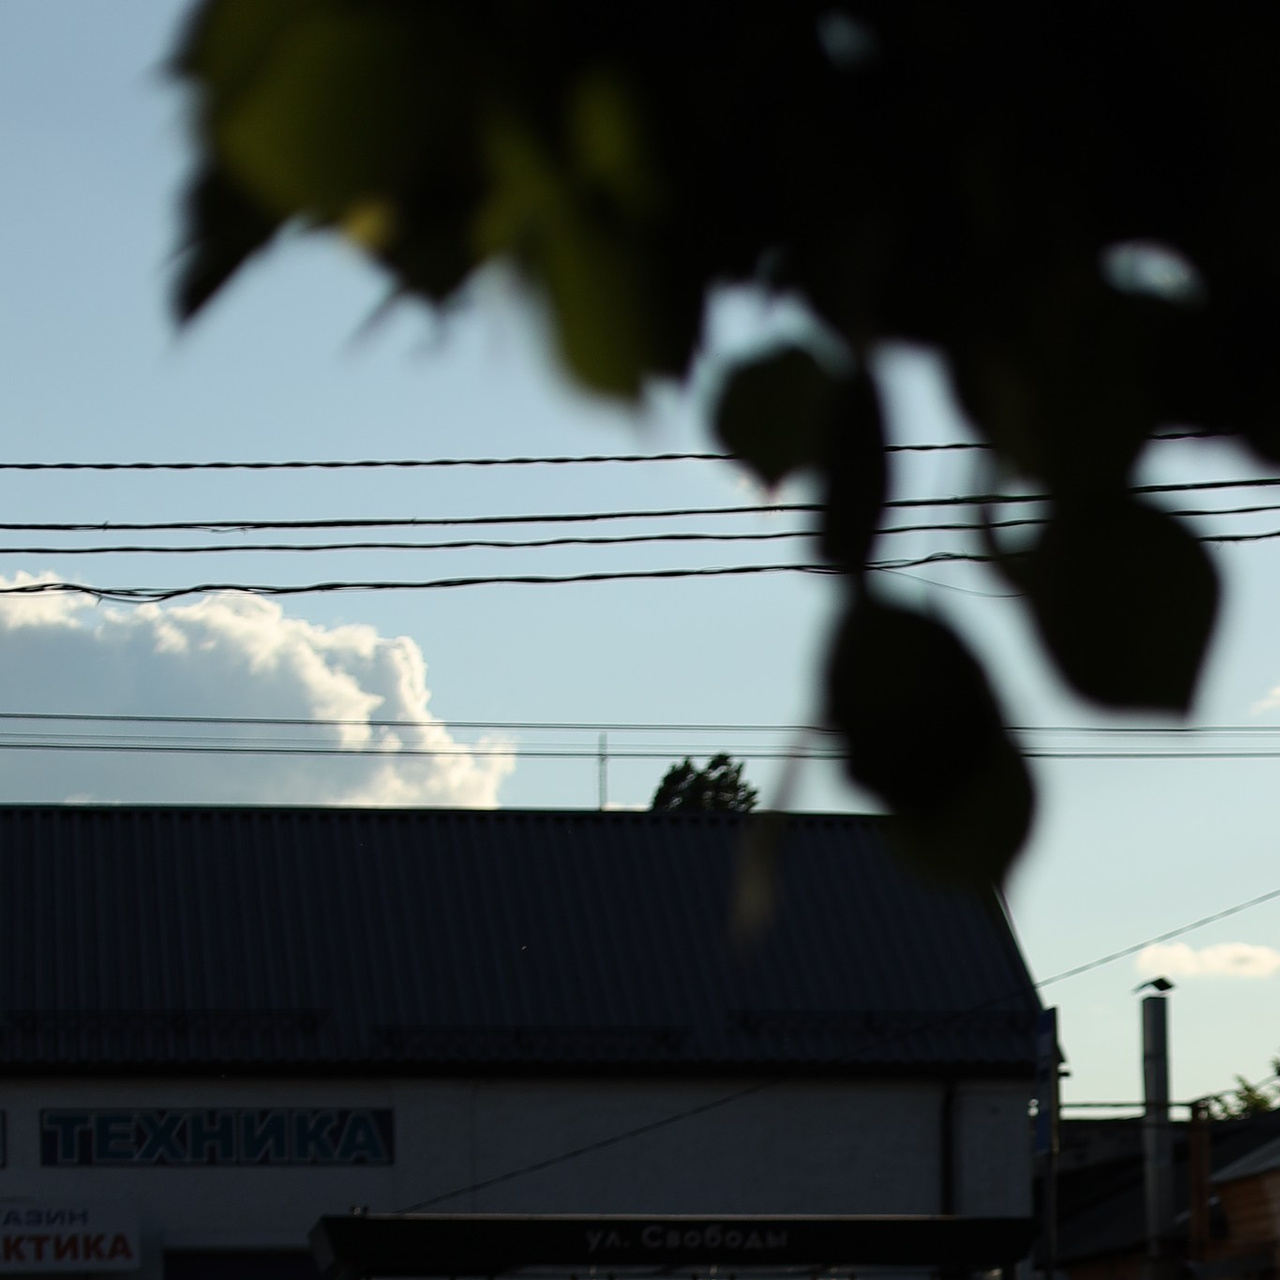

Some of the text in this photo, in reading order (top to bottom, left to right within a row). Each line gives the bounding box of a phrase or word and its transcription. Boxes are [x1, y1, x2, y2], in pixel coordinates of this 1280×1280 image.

[44, 1111, 390, 1163] ТЕХНИКА
[0, 1208, 89, 1227] АЗИН
[585, 1224, 789, 1253] ул. Свободы
